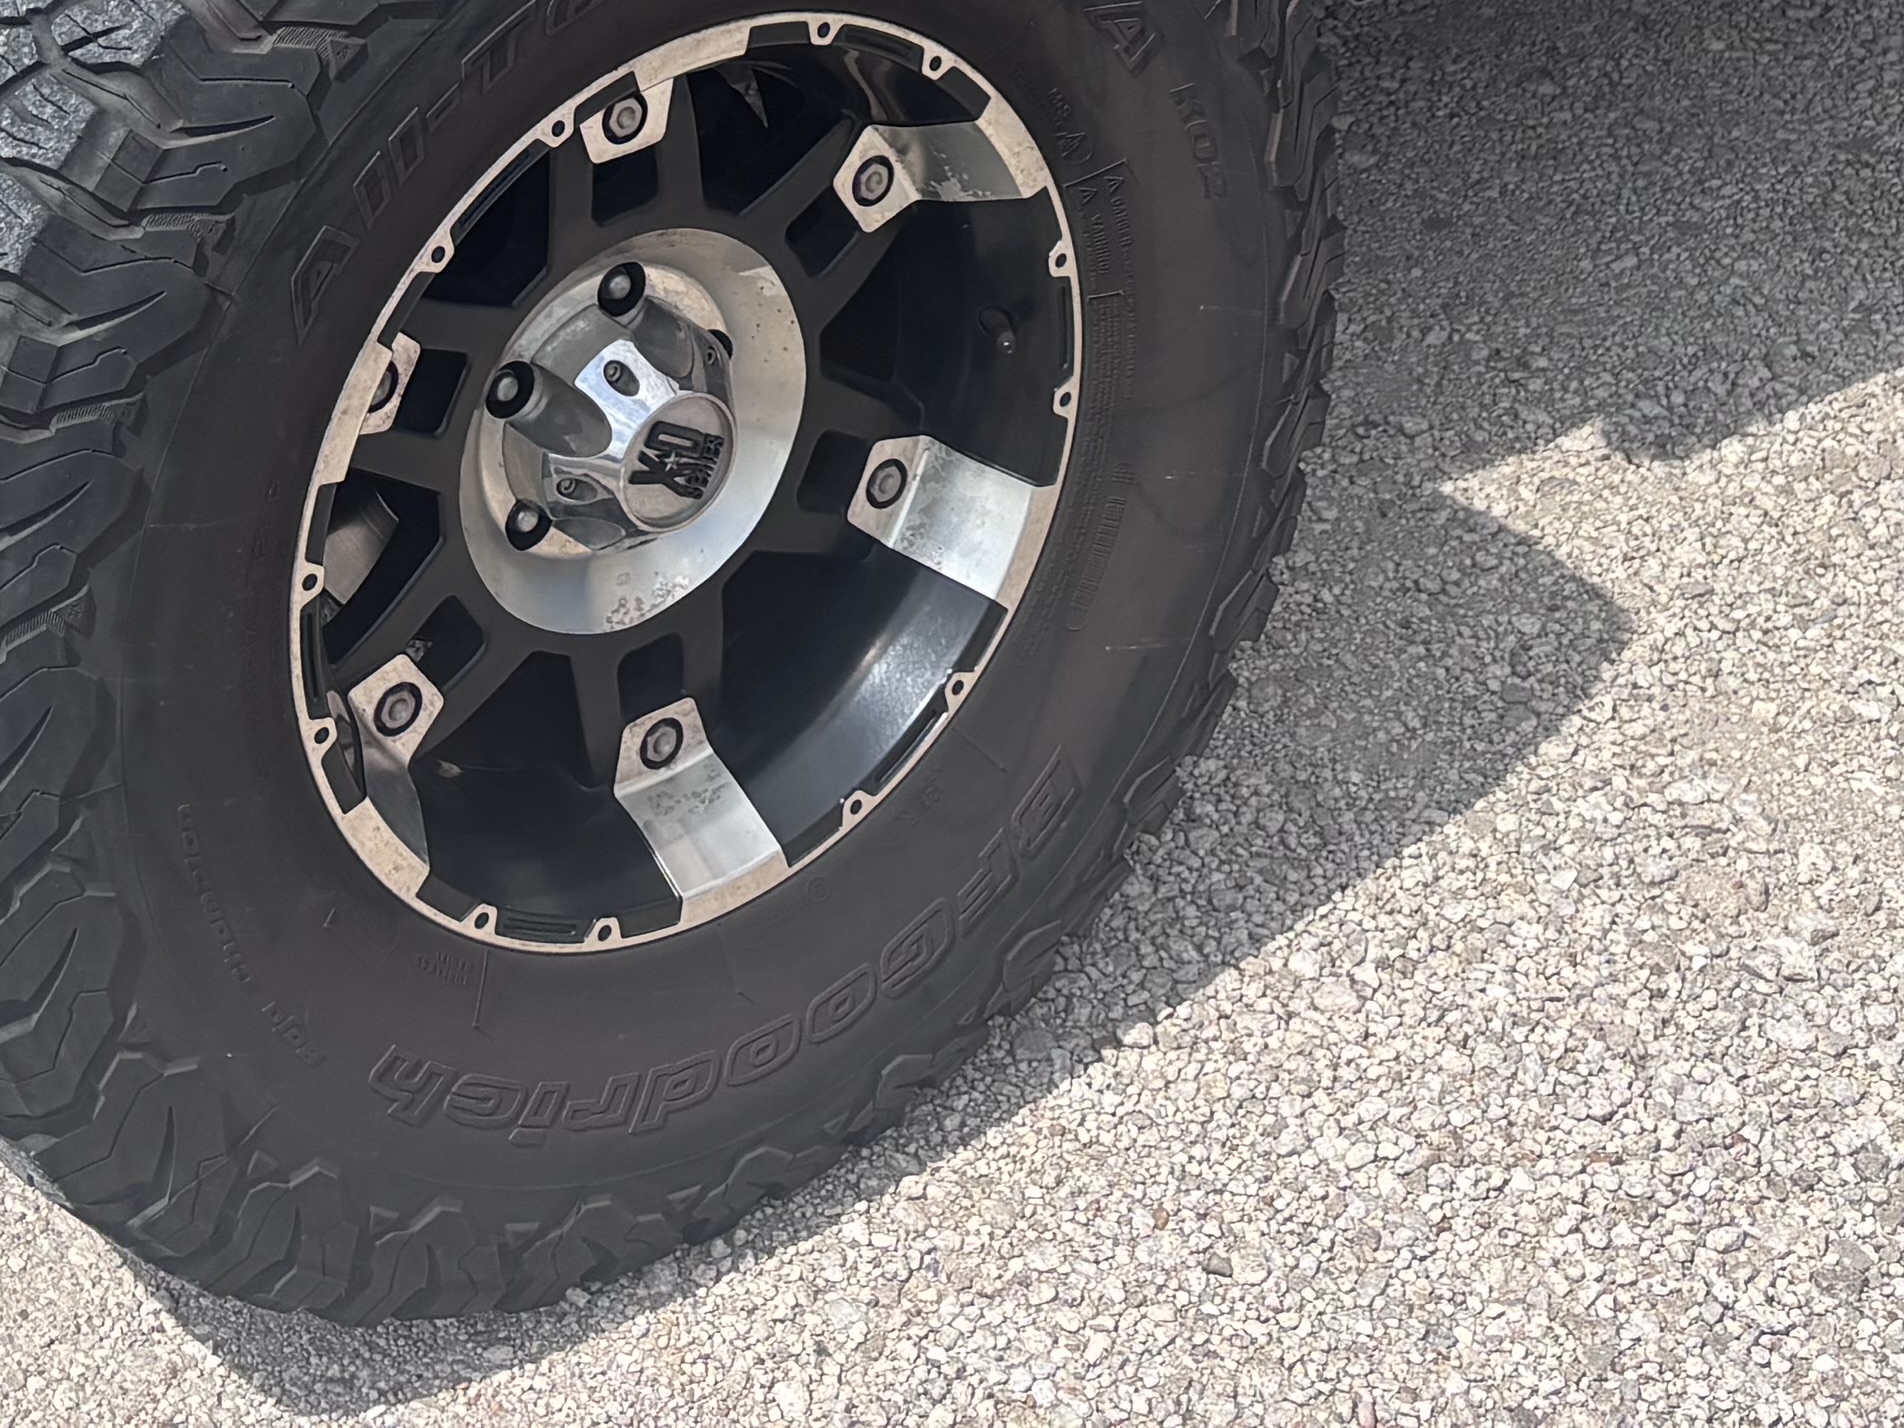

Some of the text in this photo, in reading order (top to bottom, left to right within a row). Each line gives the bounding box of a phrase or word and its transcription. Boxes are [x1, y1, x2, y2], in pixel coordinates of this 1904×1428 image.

[1168, 82, 1232, 201] KO2
[628, 420, 704, 496] XD
[368, 743, 1083, 1146] BFGoodrich
